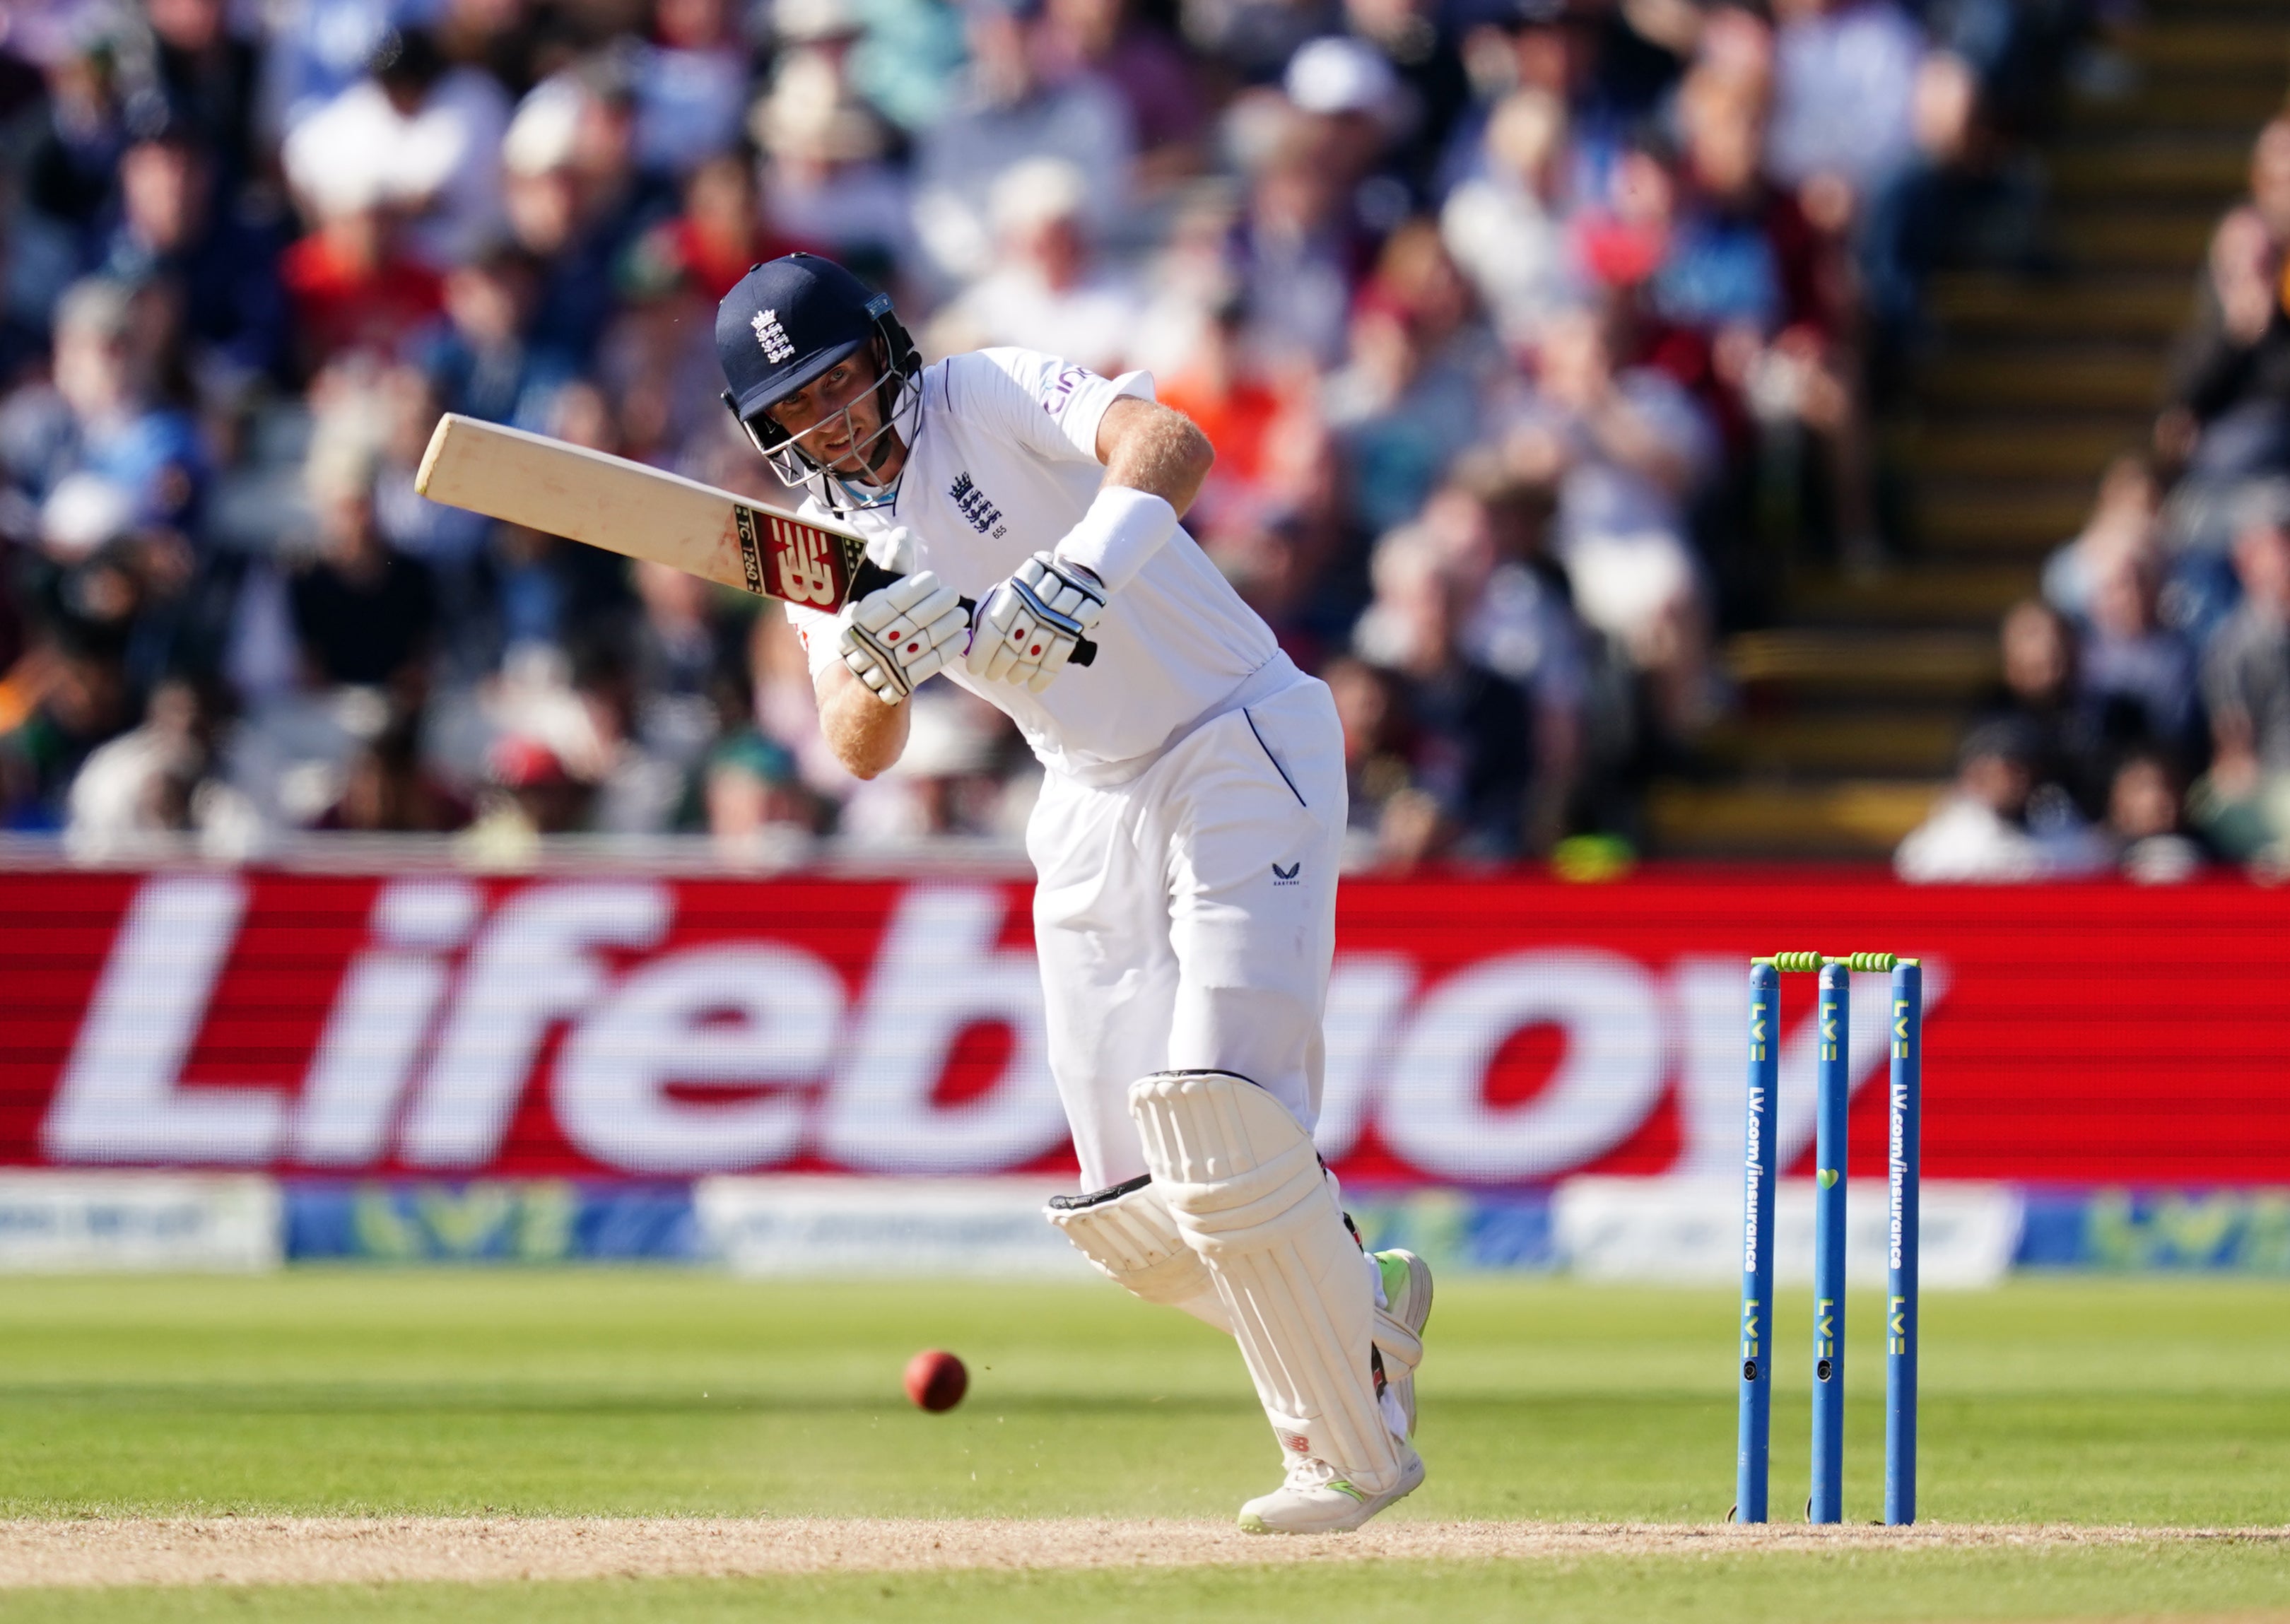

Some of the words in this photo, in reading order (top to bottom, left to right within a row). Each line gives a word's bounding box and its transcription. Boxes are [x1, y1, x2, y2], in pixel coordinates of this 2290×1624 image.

[739, 521, 751, 541] TC
[743, 546, 758, 581] 1260
[992, 524, 1007, 540] 655
[37, 875, 1952, 1179] Lifeboy
[1745, 1087, 1765, 1273] LV.com/insurance
[1889, 1083, 1908, 1270] LV.com/insurance
